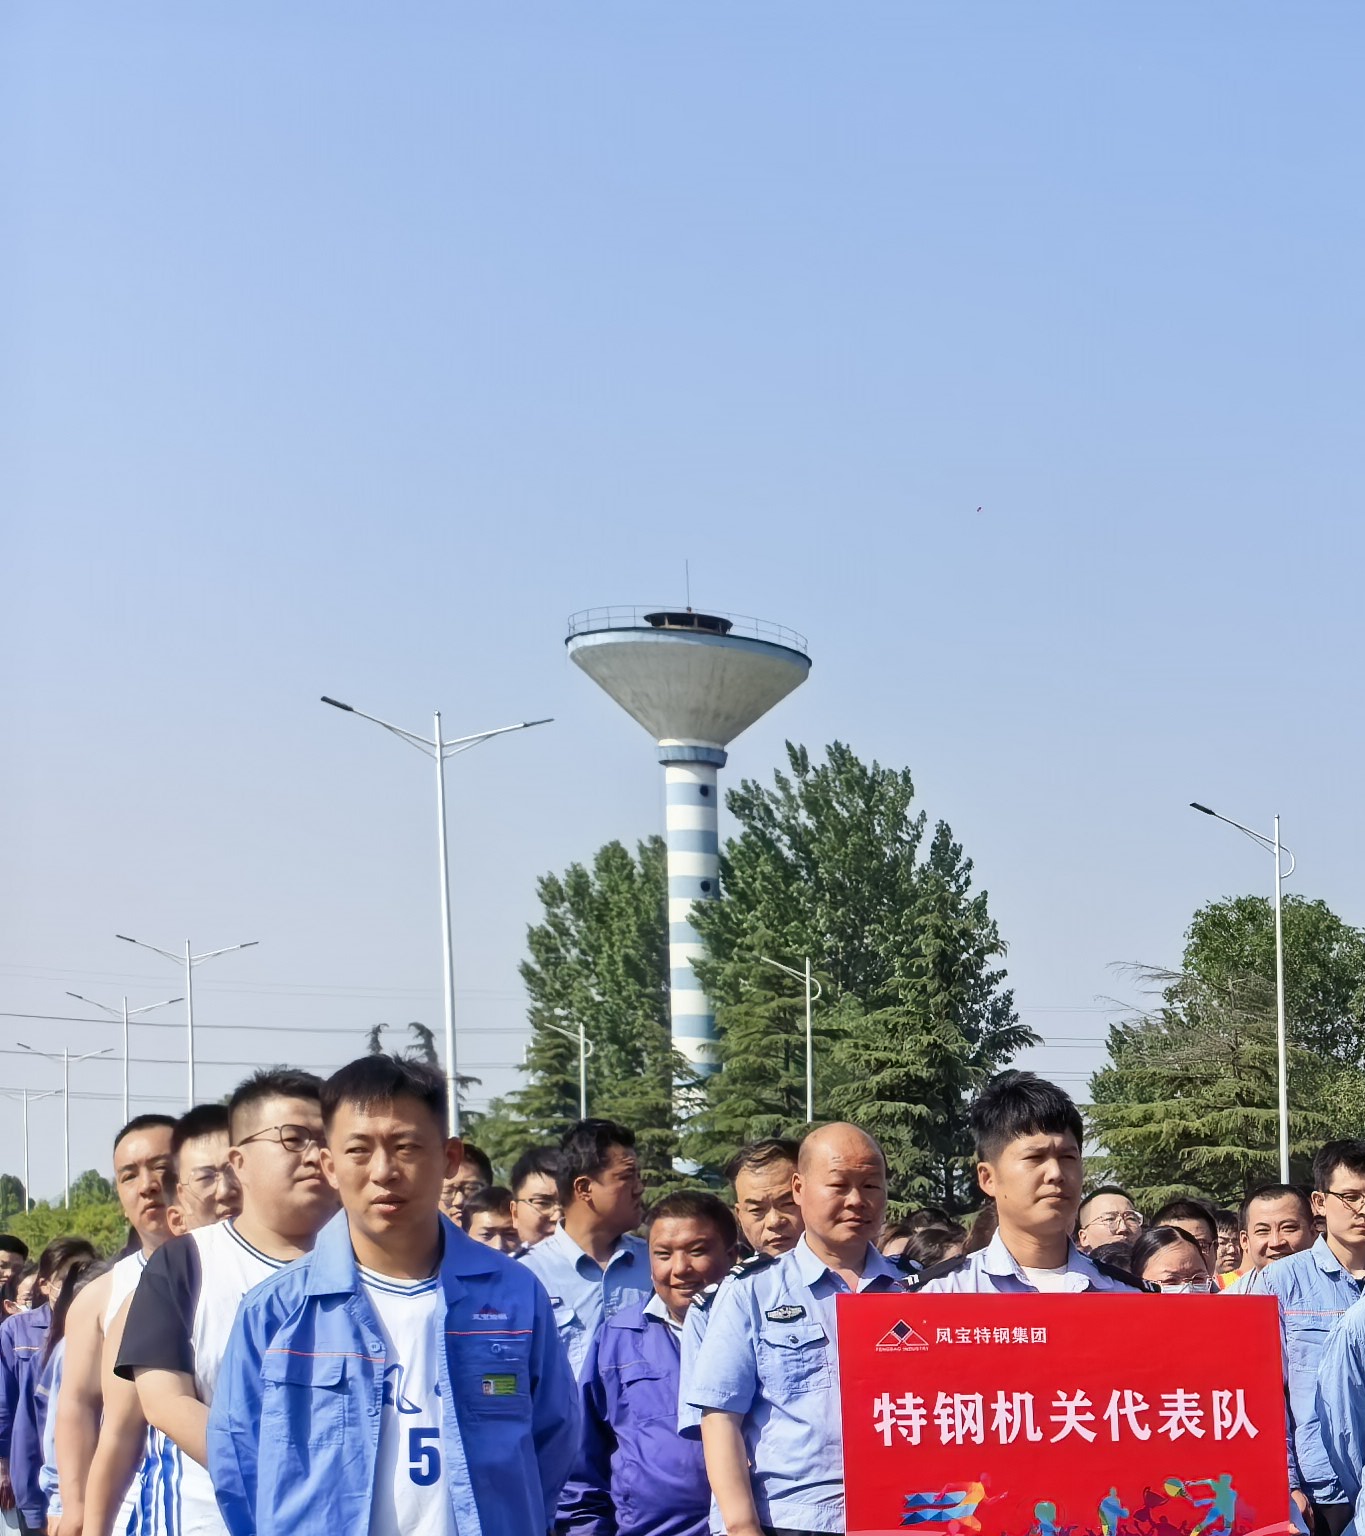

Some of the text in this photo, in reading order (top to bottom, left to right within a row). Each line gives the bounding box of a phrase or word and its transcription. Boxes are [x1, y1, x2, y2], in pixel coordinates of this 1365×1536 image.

[935, 1326, 1048, 1345] 凤宝特钢集团
[873, 1388, 1259, 1447] 特钢机关代表队
[408, 1427, 442, 1487] 5
